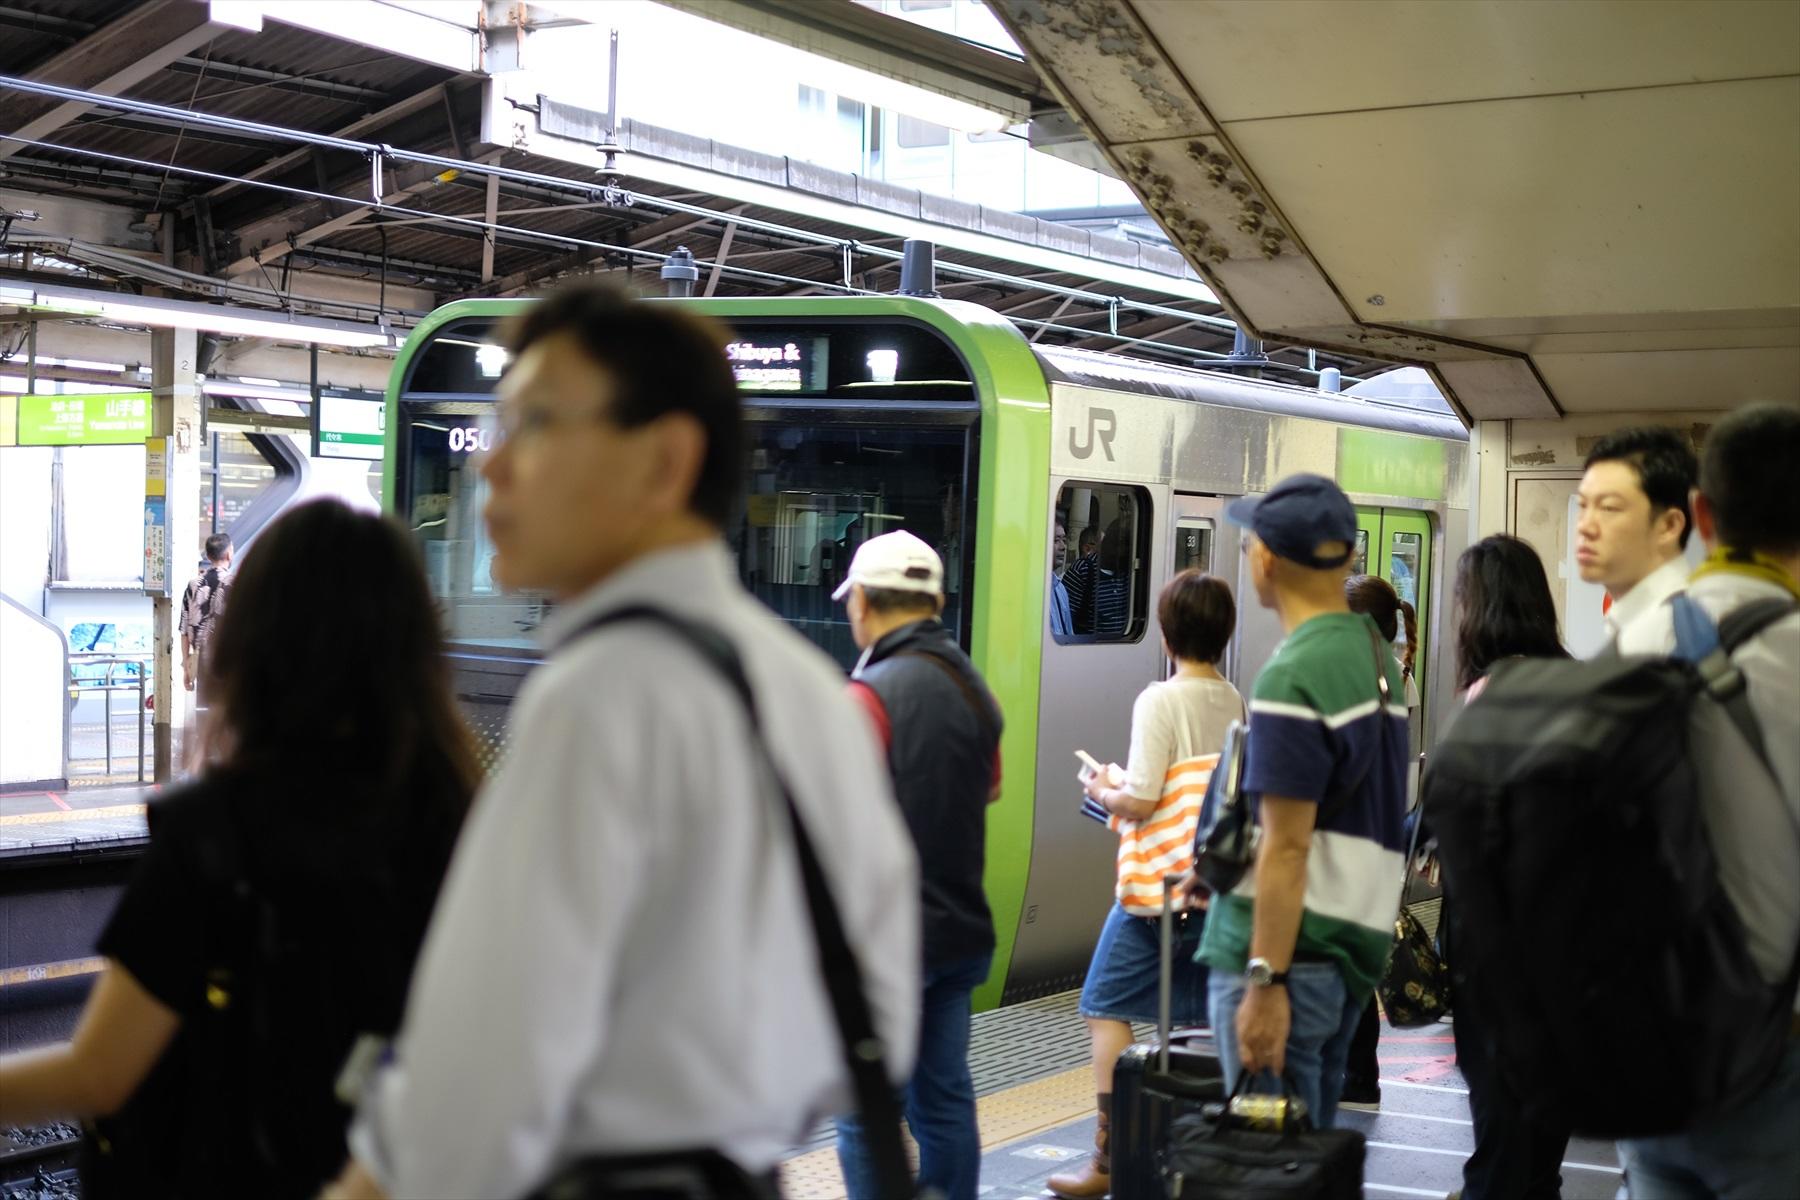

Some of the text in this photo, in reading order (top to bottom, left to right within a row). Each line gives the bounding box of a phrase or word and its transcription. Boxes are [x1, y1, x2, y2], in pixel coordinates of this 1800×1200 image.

[726, 343, 801, 364] Shibuya &
[182, 360, 189, 370] 2
[1069, 407, 1117, 462] JR
[1186, 535, 1196, 548] 33
